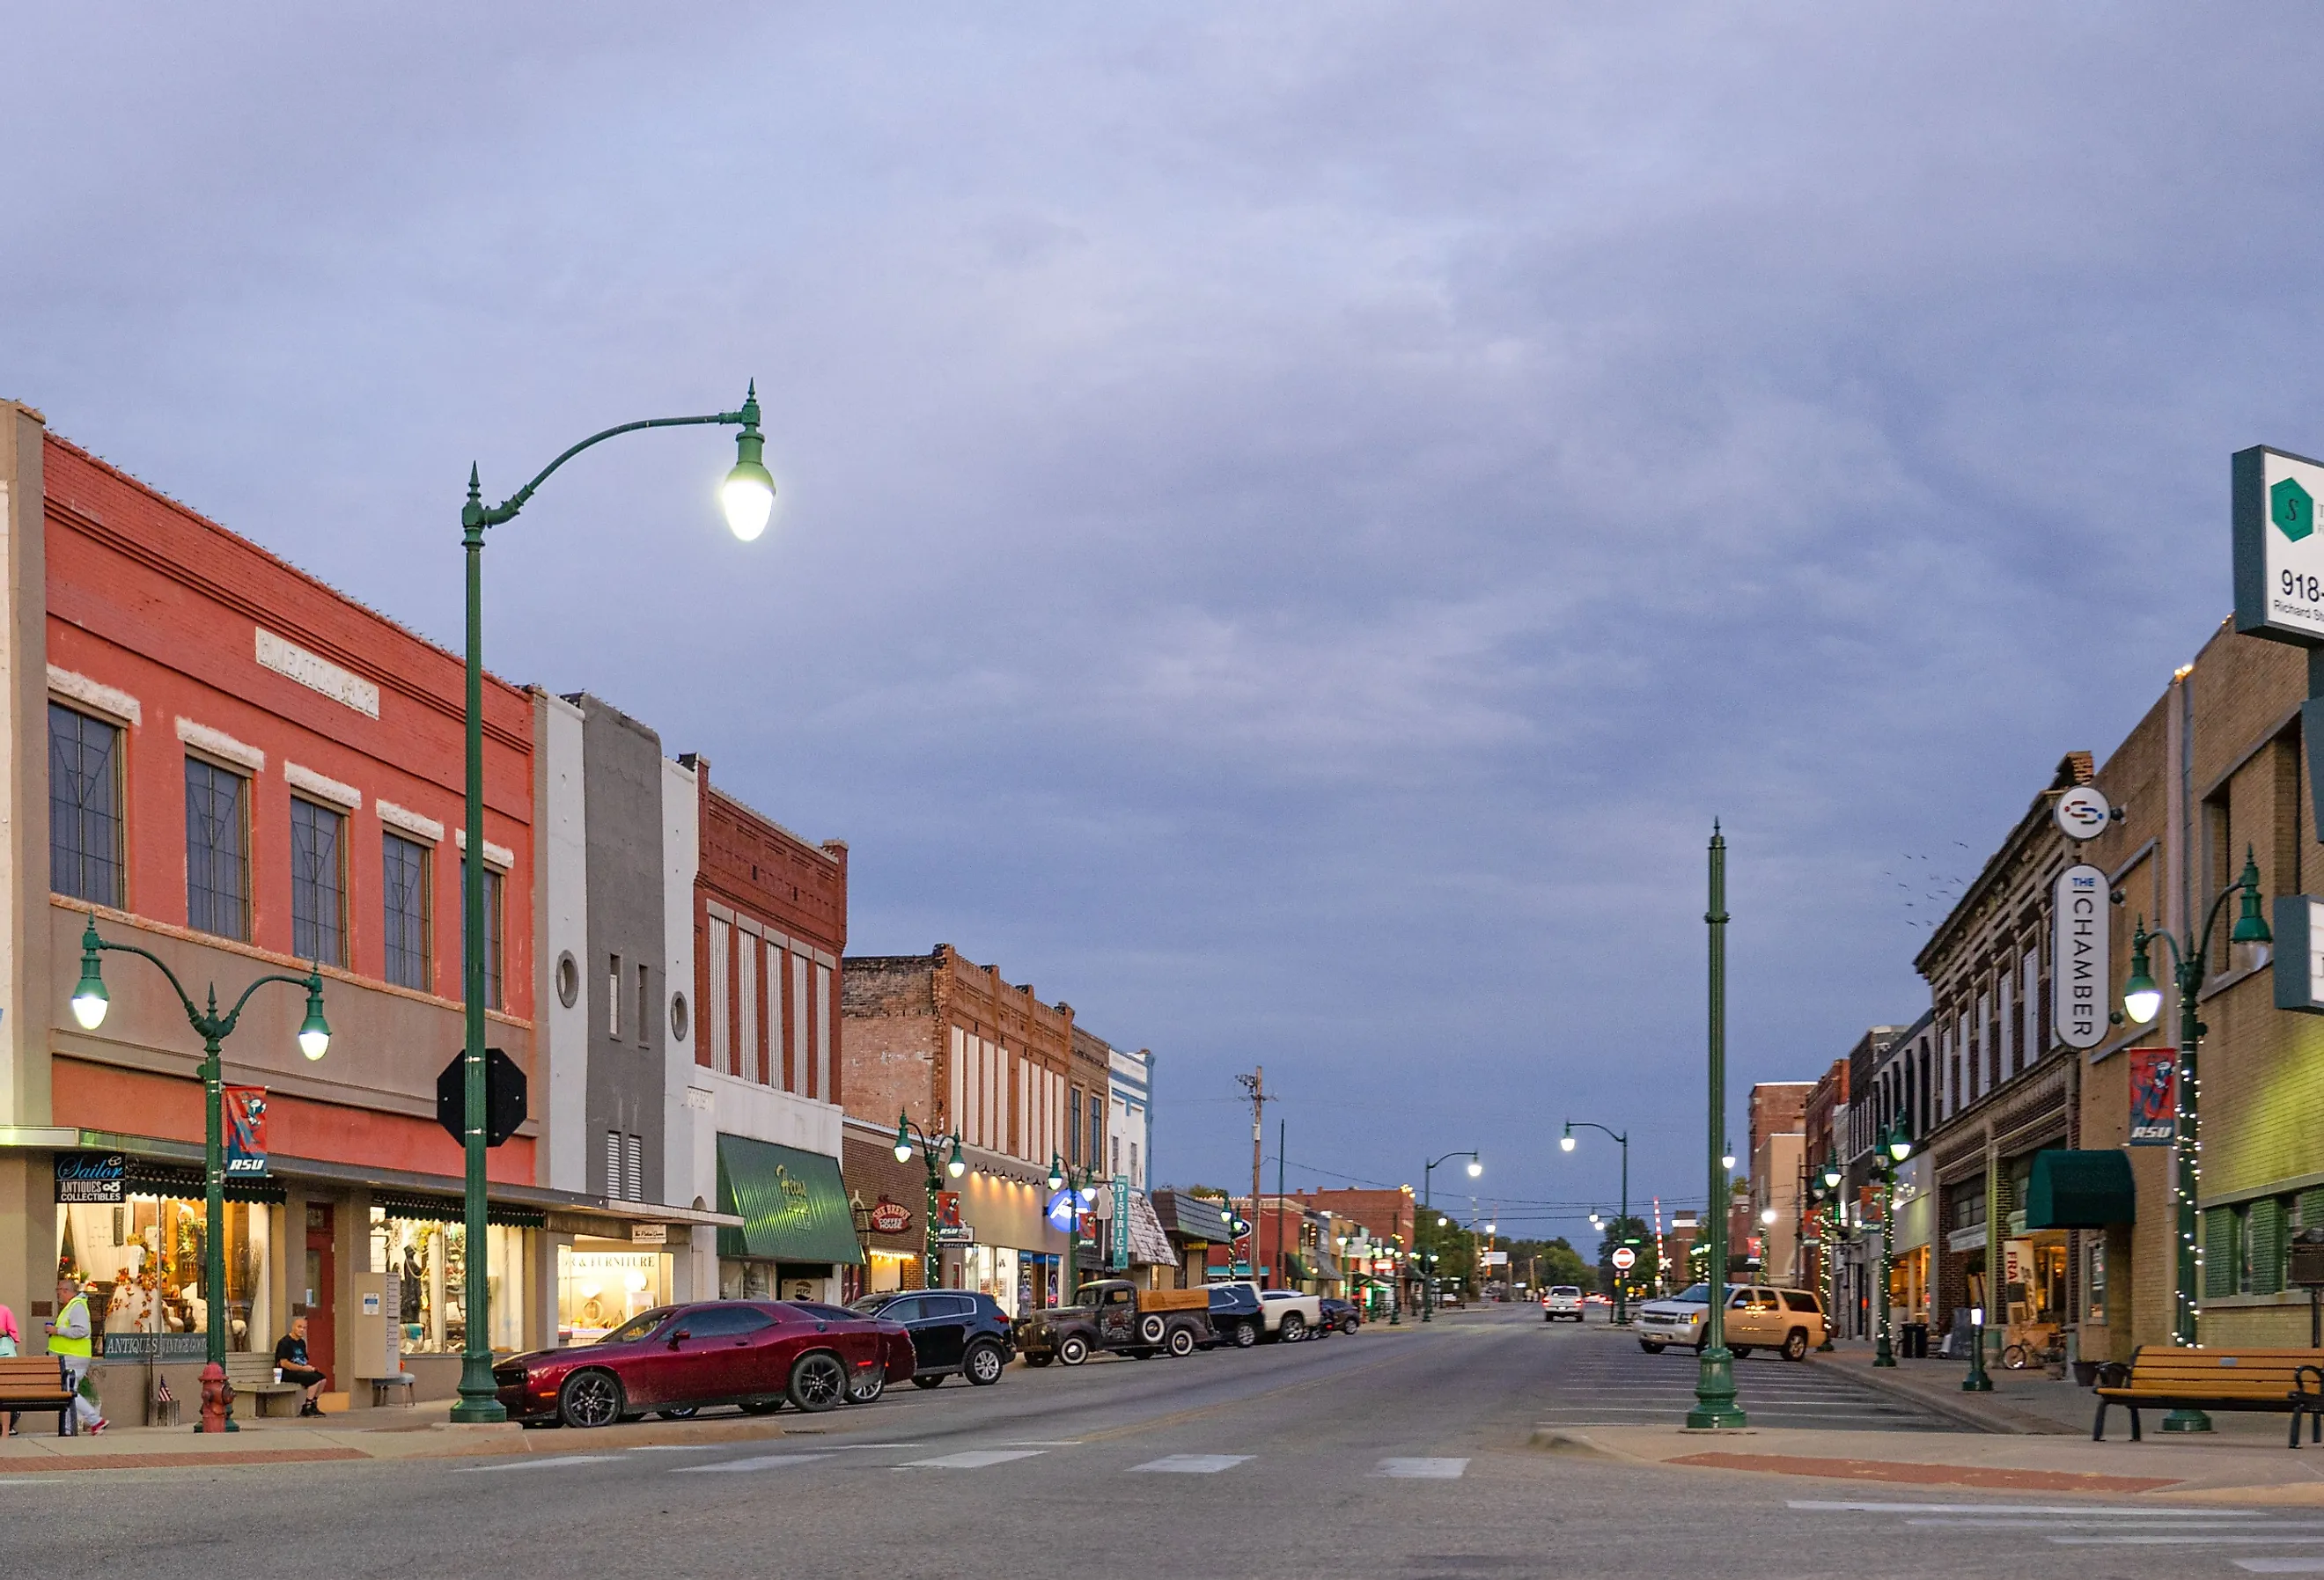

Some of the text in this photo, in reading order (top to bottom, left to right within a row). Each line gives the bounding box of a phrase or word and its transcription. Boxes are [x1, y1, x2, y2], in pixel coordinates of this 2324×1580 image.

[2274, 599, 2311, 618] Richard
[2072, 878, 2094, 886] THE
[2073, 898, 2093, 1036] CHAMBER
[2131, 1128, 2173, 1138] RSU
[58, 1157, 123, 1180] Sailor
[230, 1159, 264, 1171] RSU
[62, 1181, 101, 1193] ANTIQUES
[872, 1204, 911, 1220] SHE BREWS
[1116, 1184, 1125, 1255] DISTRICT
[592, 1256, 655, 1268] FURNITURE
